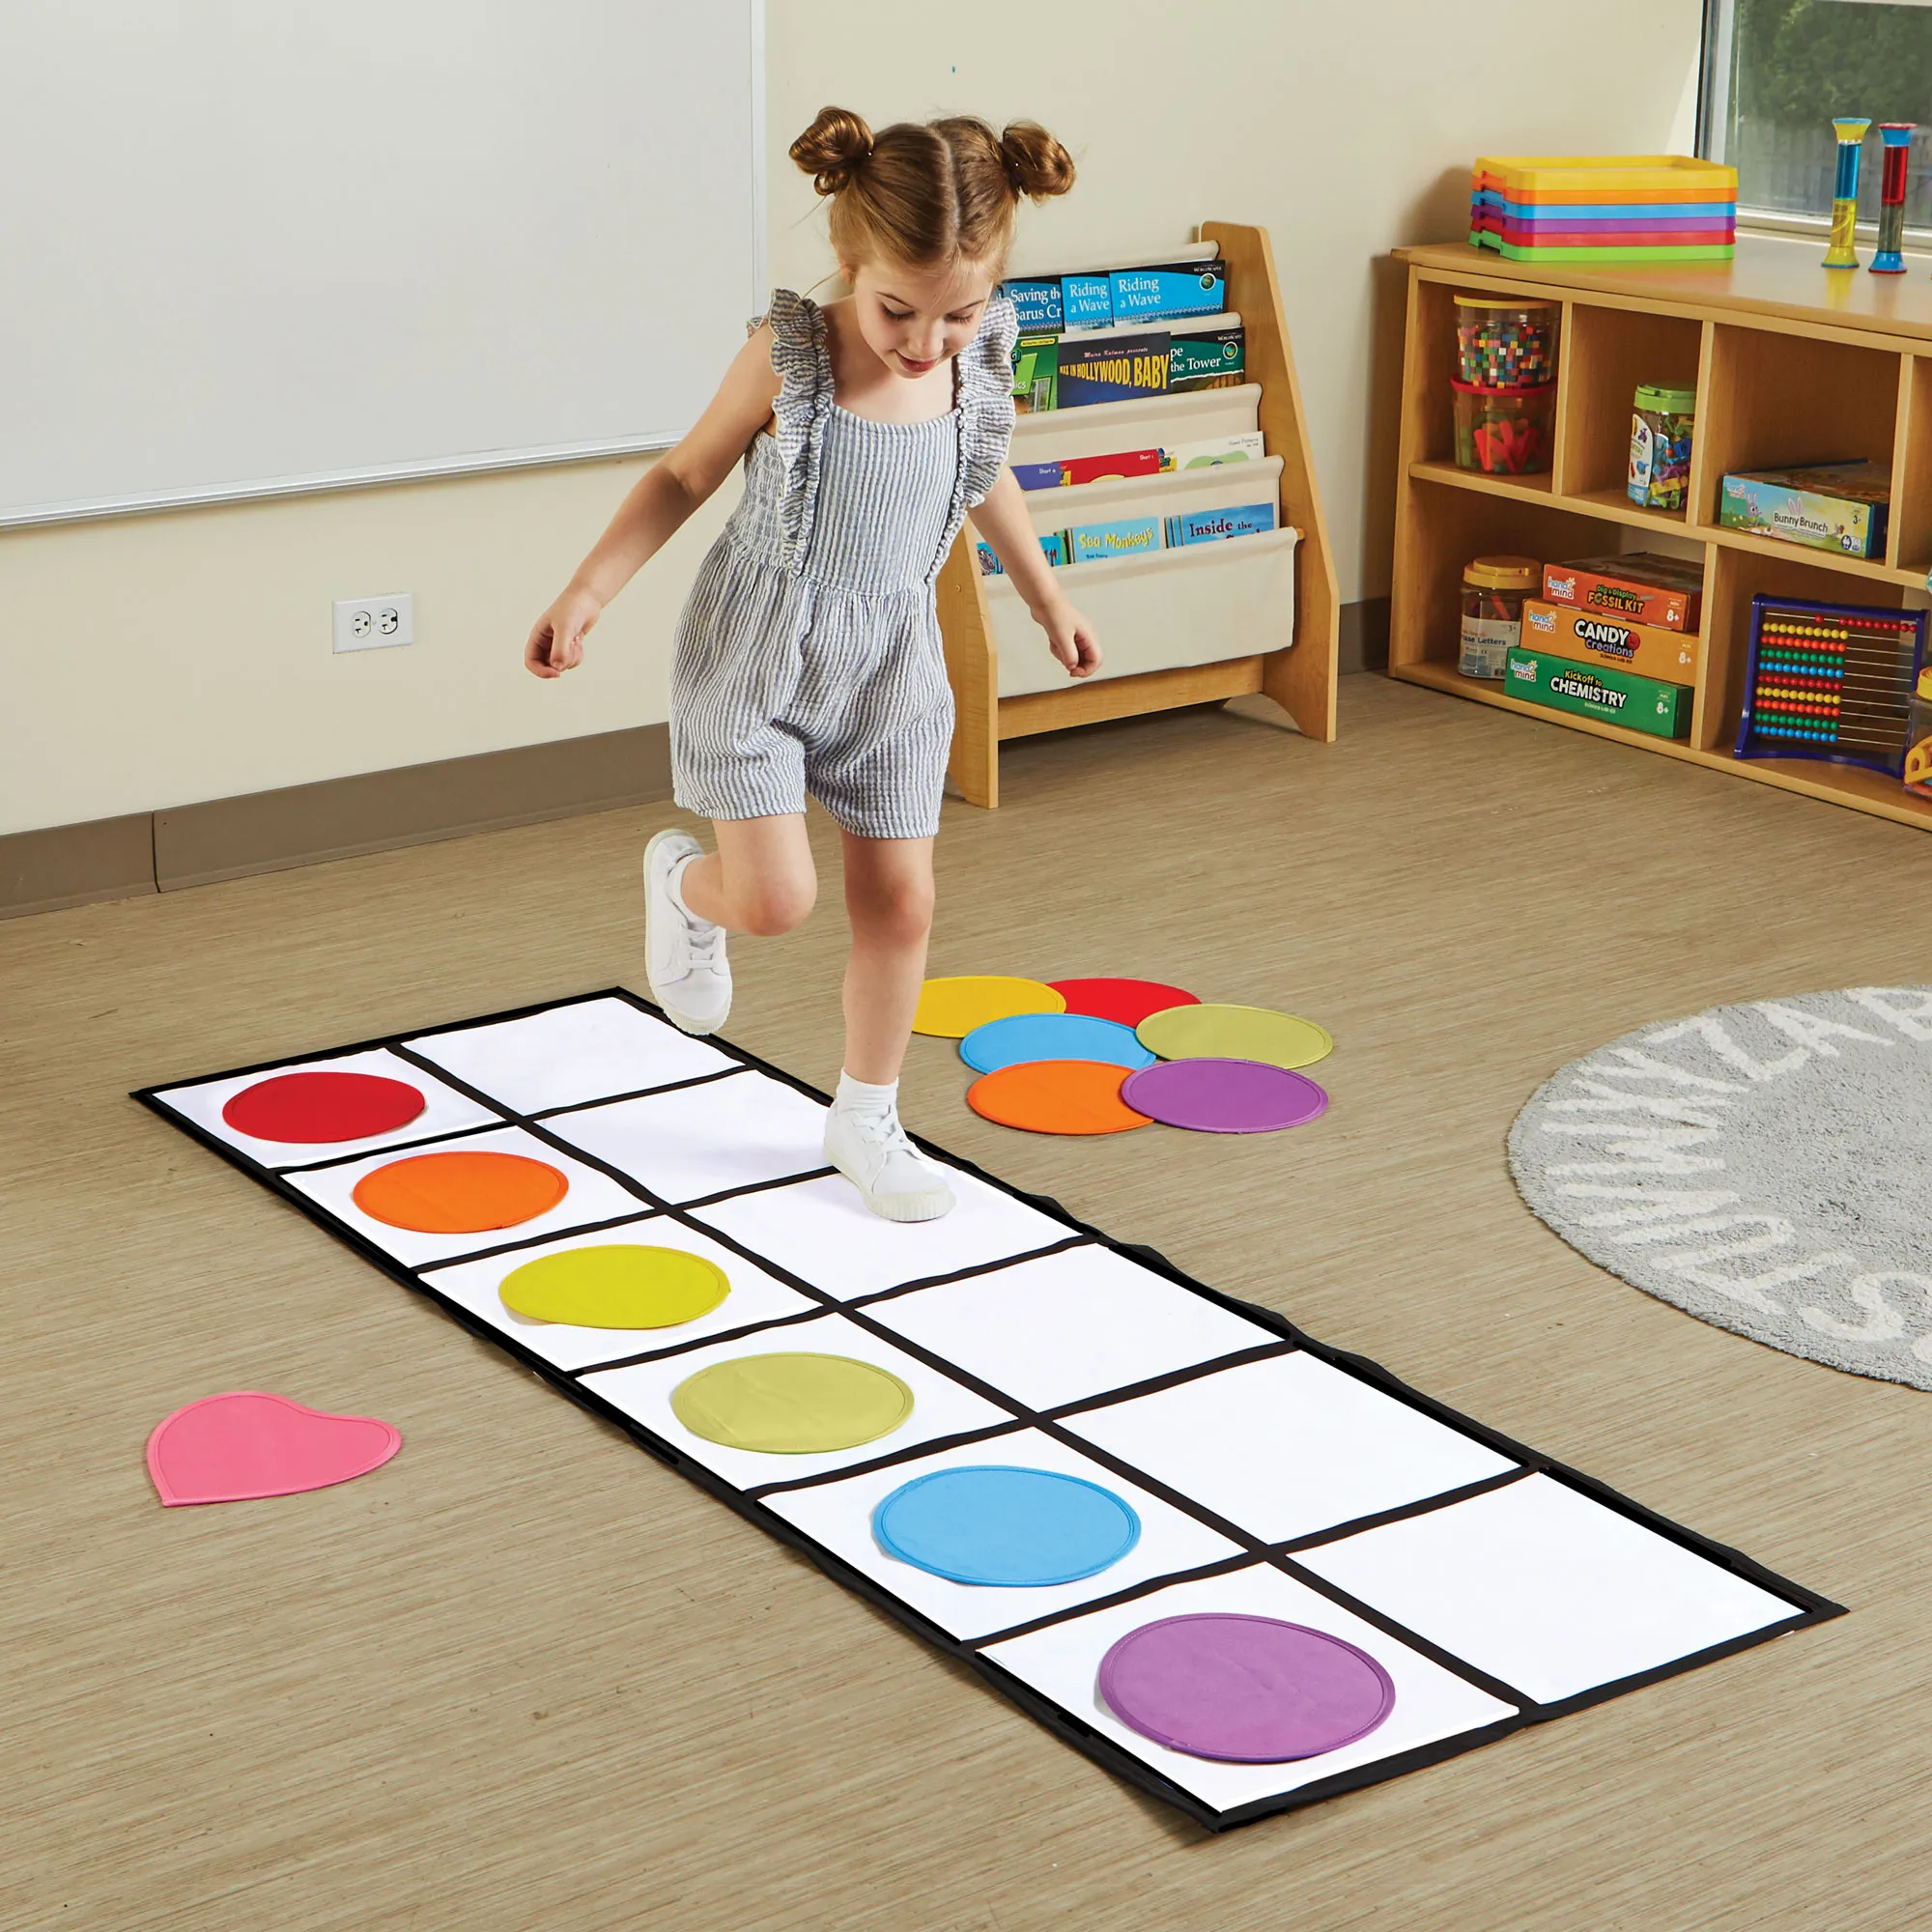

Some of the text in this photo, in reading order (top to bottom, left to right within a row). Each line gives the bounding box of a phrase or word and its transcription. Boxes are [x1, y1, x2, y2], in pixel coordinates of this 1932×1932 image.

[1069, 282, 1108, 298] Riding
[1118, 277, 1160, 294] Riding
[1010, 287, 1049, 304] Saving
[1050, 286, 1062, 298] th
[1120, 293, 1161, 308] a Wave
[1070, 298, 1110, 314] a Wave
[1069, 364, 1077, 377] IN
[1077, 358, 1132, 388] HOLLYWOOD,
[1133, 354, 1170, 389] BABY
[1170, 361, 1185, 372] the
[1186, 356, 1221, 370] Tower
[1189, 518, 1234, 538] Inside
[1237, 521, 1253, 530] the
[1774, 512, 1799, 527] Bunny
[1799, 517, 1829, 533] Brunch
[1079, 526, 1154, 550] Sea Monkeys
[1551, 587, 1574, 599] mind
[1596, 584, 1607, 594] Dig
[1613, 587, 1637, 600] Display
[1588, 591, 1644, 613] FOSSIL KIT
[1666, 609, 1679, 622] 8+
[1533, 621, 1555, 632] mind
[1575, 619, 1630, 646] CANDY
[1477, 638, 1507, 646] Letters
[1678, 652, 1691, 664] 8+
[1515, 670, 1536, 682] mind
[1564, 669, 1603, 687] Kickoff to
[1549, 677, 1628, 708] CHEMISTRY
[1656, 701, 1669, 715] 8+
